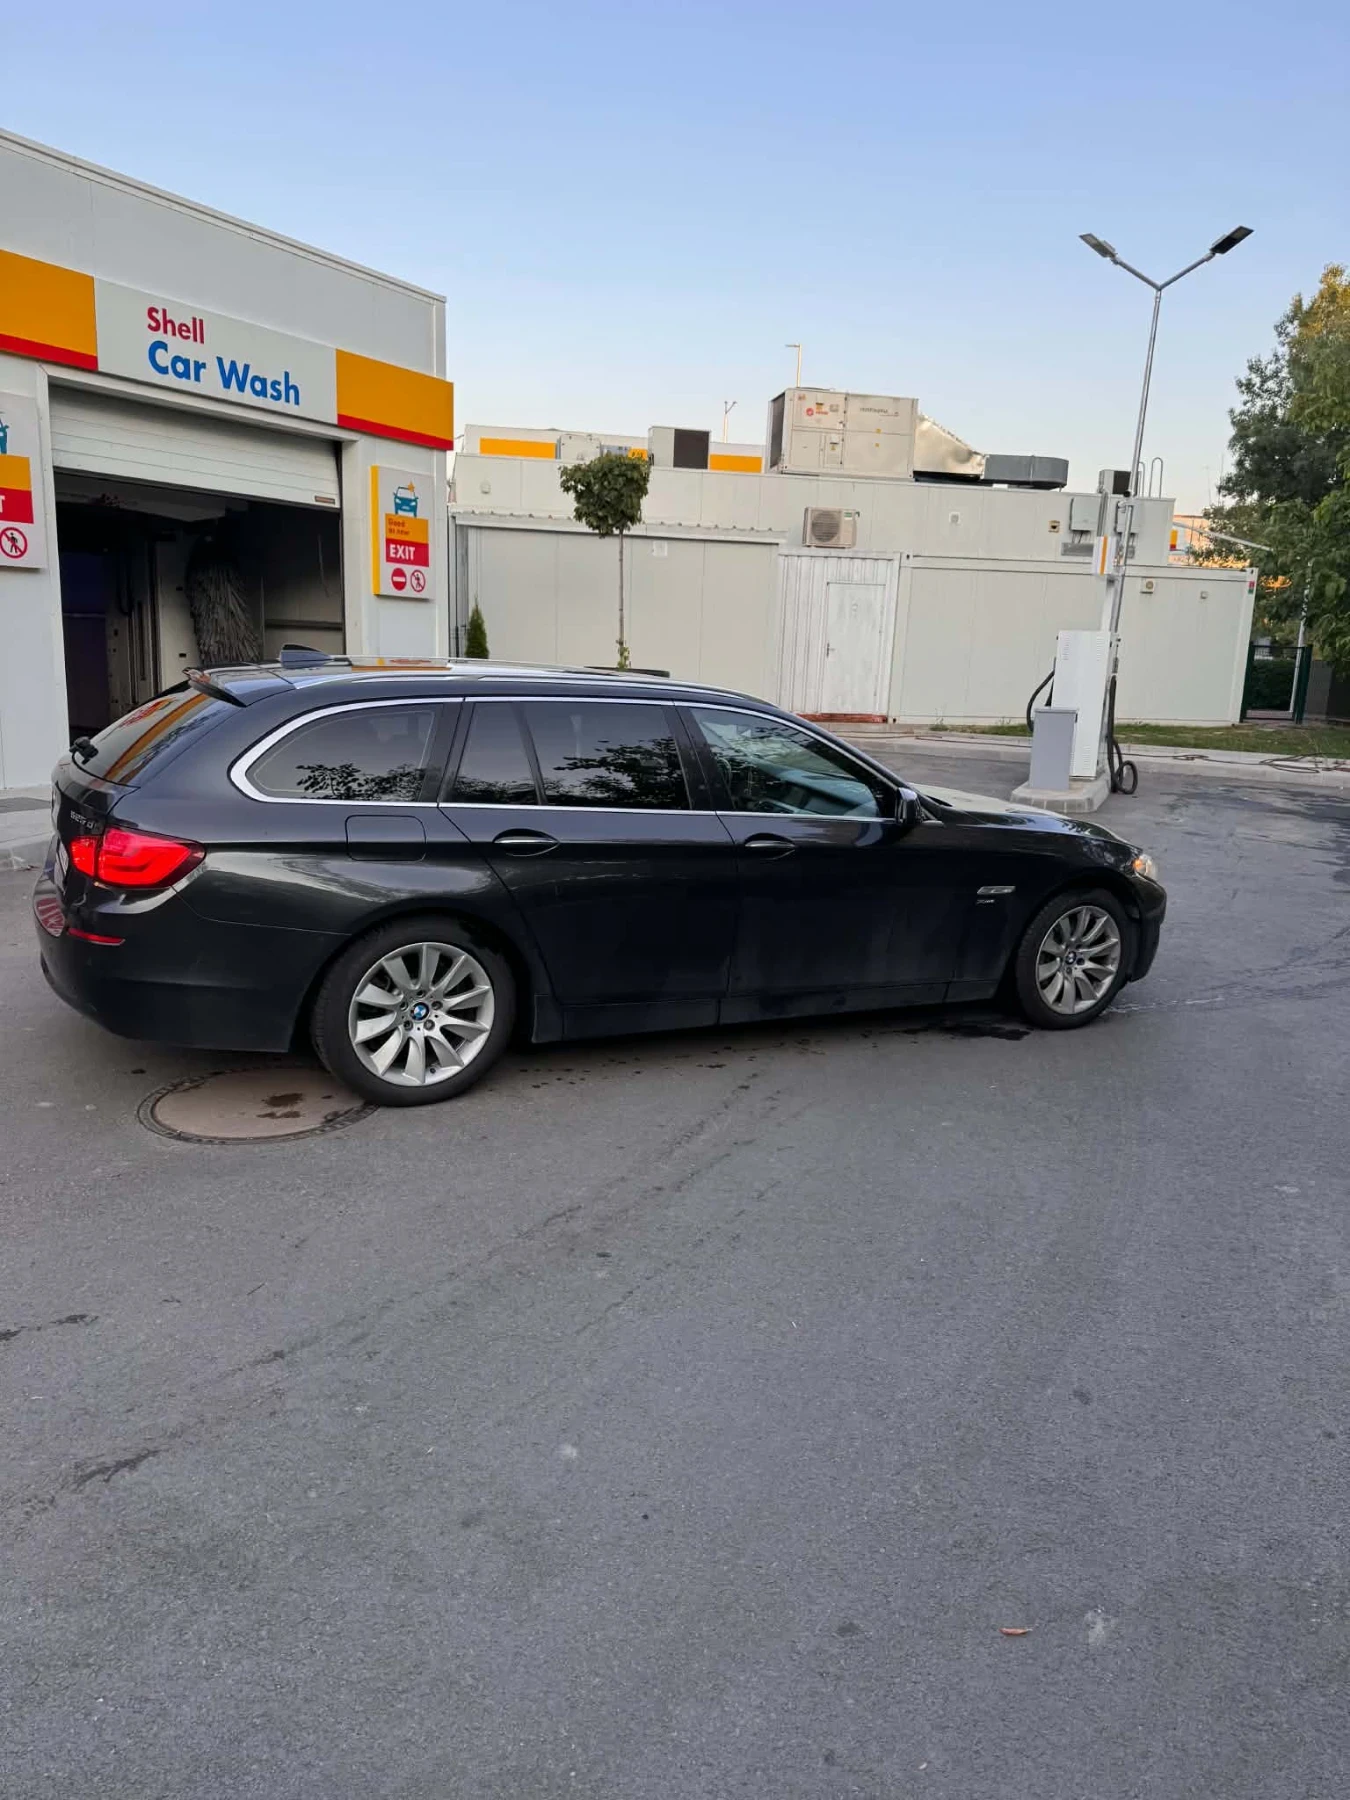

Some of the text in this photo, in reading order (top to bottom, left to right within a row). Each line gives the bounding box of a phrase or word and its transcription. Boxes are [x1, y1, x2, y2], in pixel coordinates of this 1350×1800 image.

[147, 306, 204, 344] Shell
[148, 340, 300, 406] Car Wash
[388, 518, 406, 528] Good
[389, 544, 416, 561] EXIT
